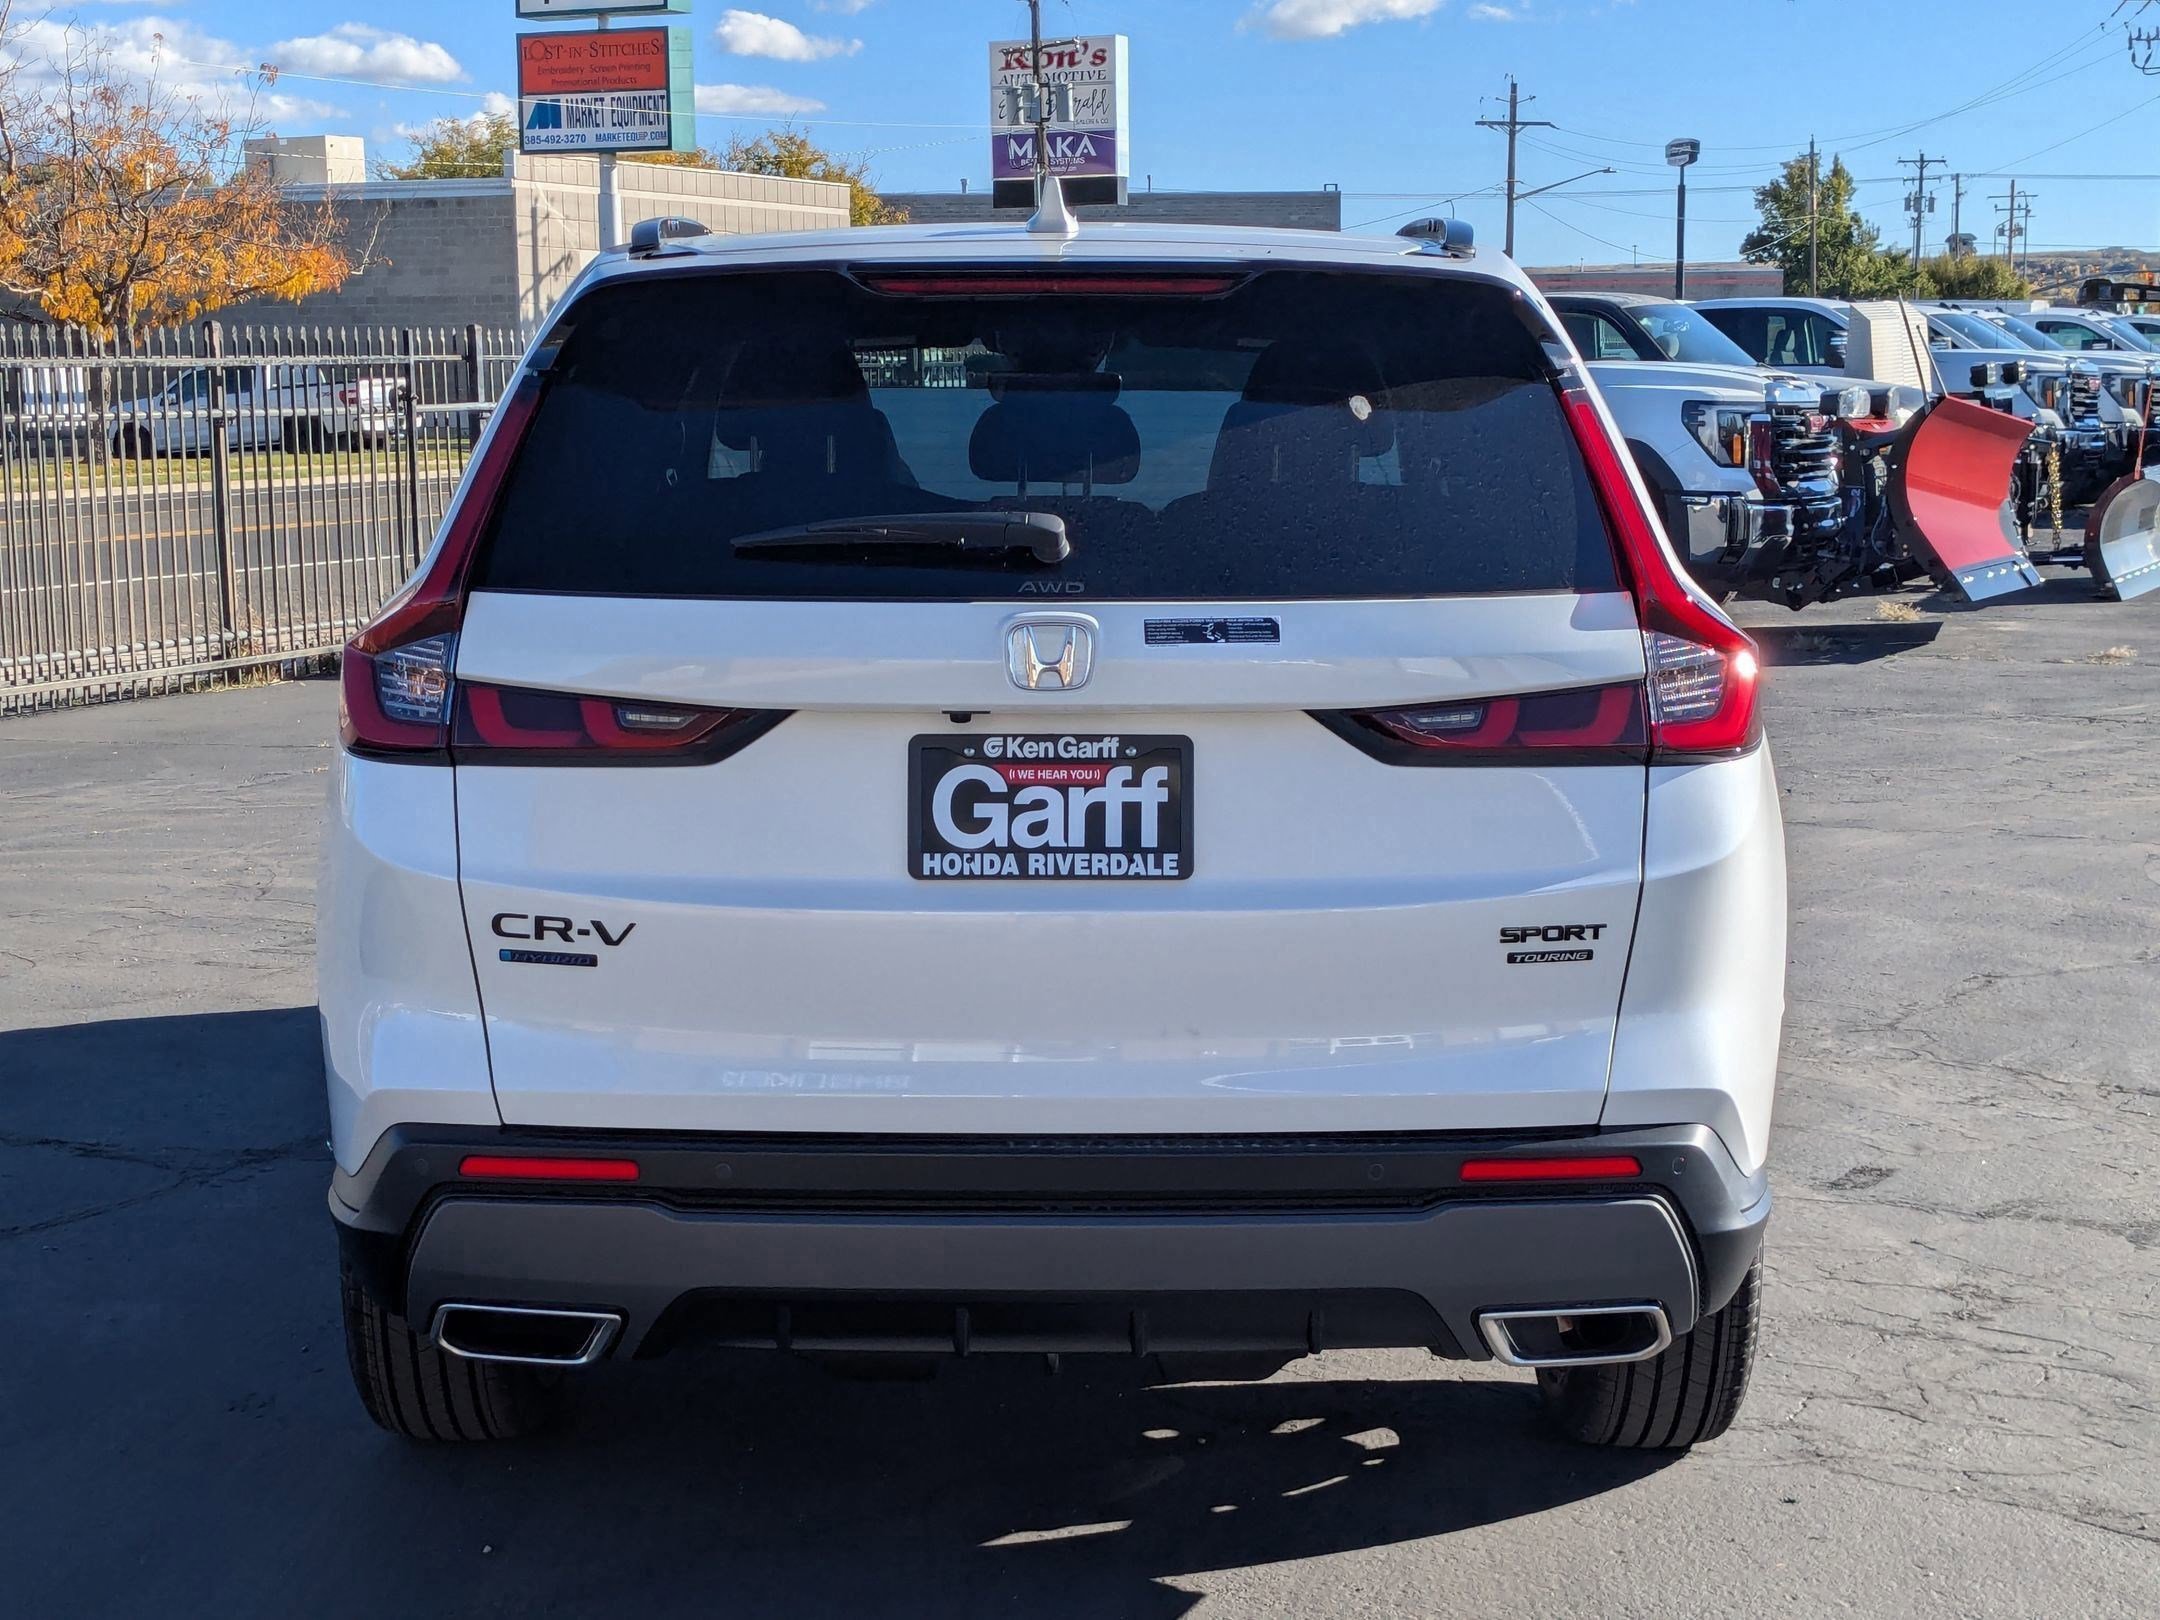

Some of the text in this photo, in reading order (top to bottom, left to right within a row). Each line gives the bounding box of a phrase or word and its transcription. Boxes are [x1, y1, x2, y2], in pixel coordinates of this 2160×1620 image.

[999, 70, 1107, 85] AUTMOTIVE
[565, 94, 665, 129] MARKET EQUIPMENT
[524, 133, 587, 145] 385-492-3270
[1018, 581, 1085, 593] AWD
[1007, 736, 1119, 759] Ken Garff
[1018, 769, 1093, 780] WE HEAR YOU
[932, 764, 1169, 850] Garff
[923, 853, 1179, 876] HONDA RIVERDALE
[491, 912, 637, 946] CR-V
[1499, 923, 1608, 944] SPORT
[1513, 951, 1589, 963] TOURING
